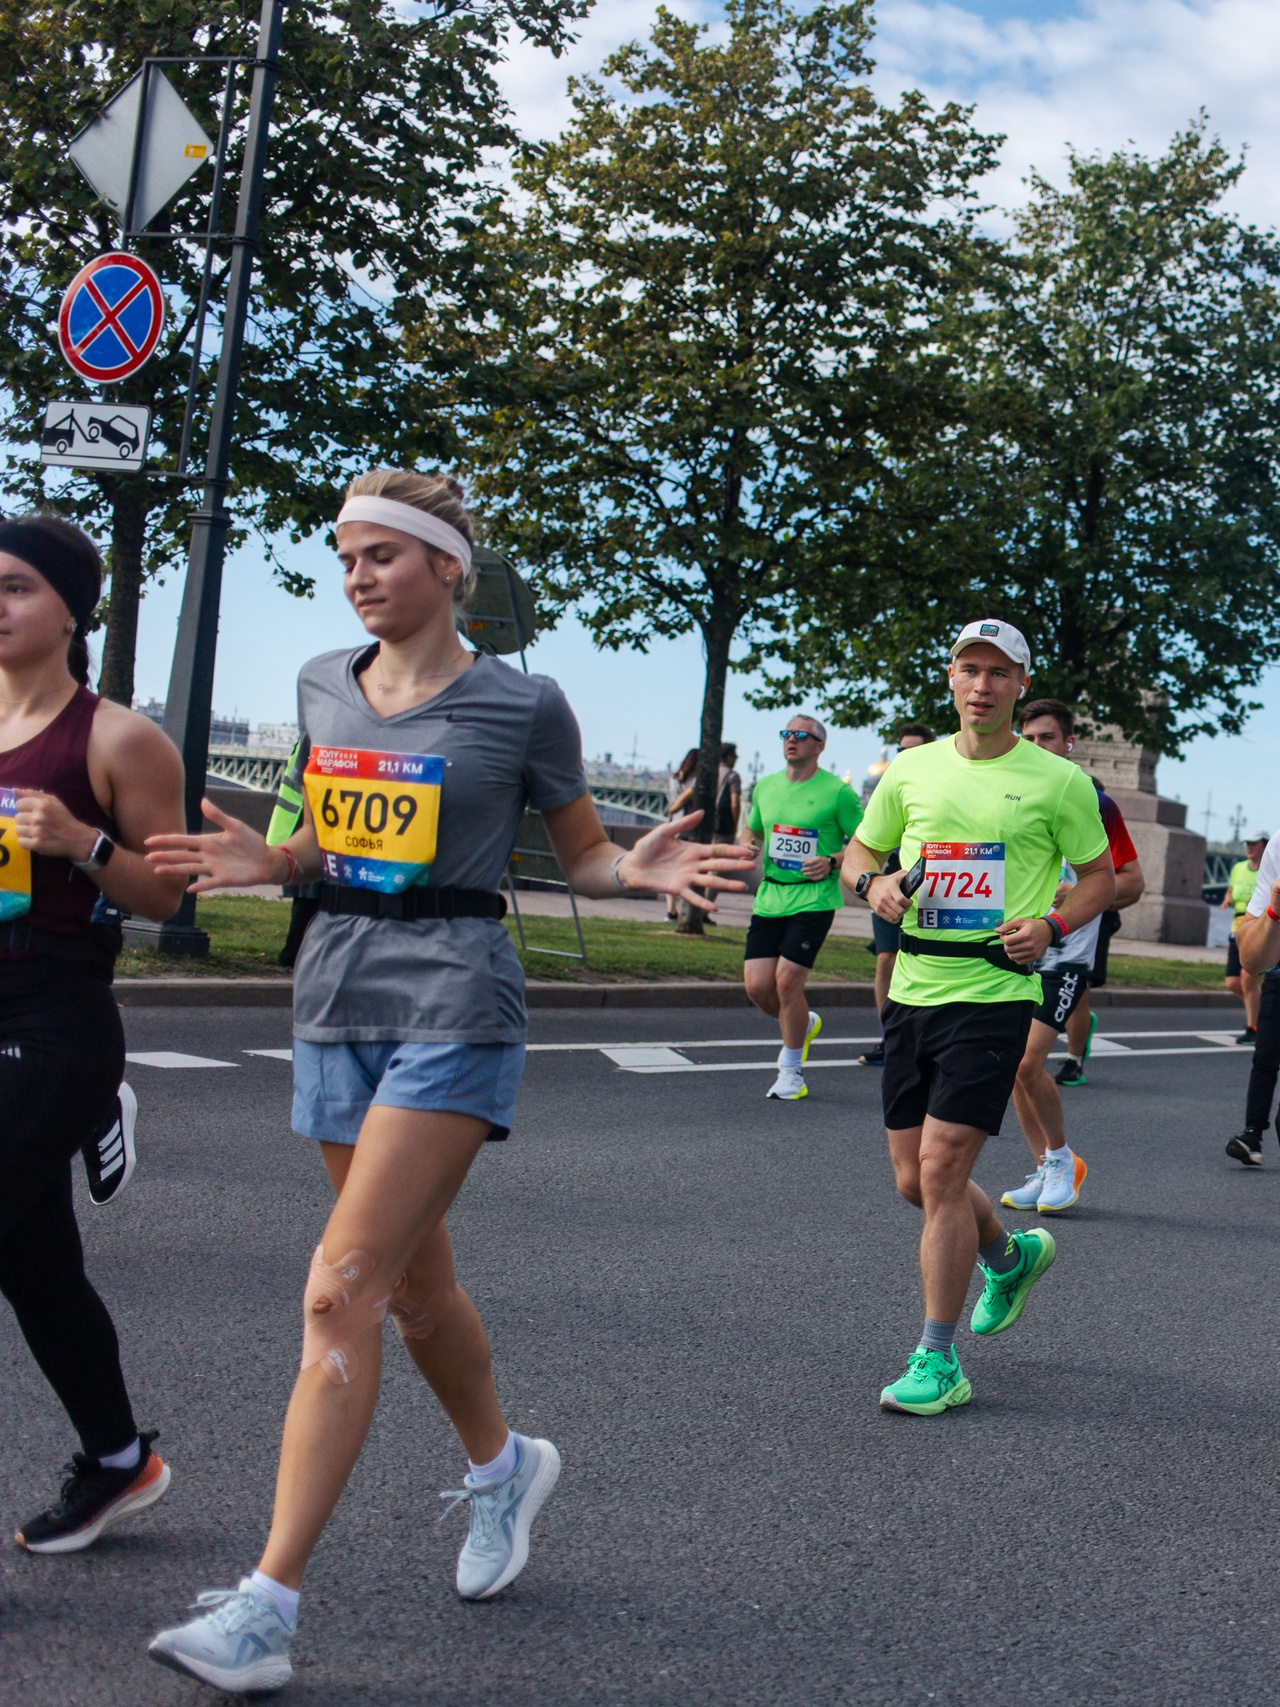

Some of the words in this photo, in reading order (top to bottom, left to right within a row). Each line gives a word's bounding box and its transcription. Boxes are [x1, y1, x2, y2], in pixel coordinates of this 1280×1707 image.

[317, 758, 358, 769] МАРАФОН
[378, 760, 400, 774] 21,1
[402, 762, 423, 775] КМ
[1004, 793, 1021, 801] RUN
[321, 788, 418, 836] 6709
[345, 836, 383, 851] СОФЬЯ
[776, 837, 811, 854] 2530
[925, 872, 992, 898] 7724
